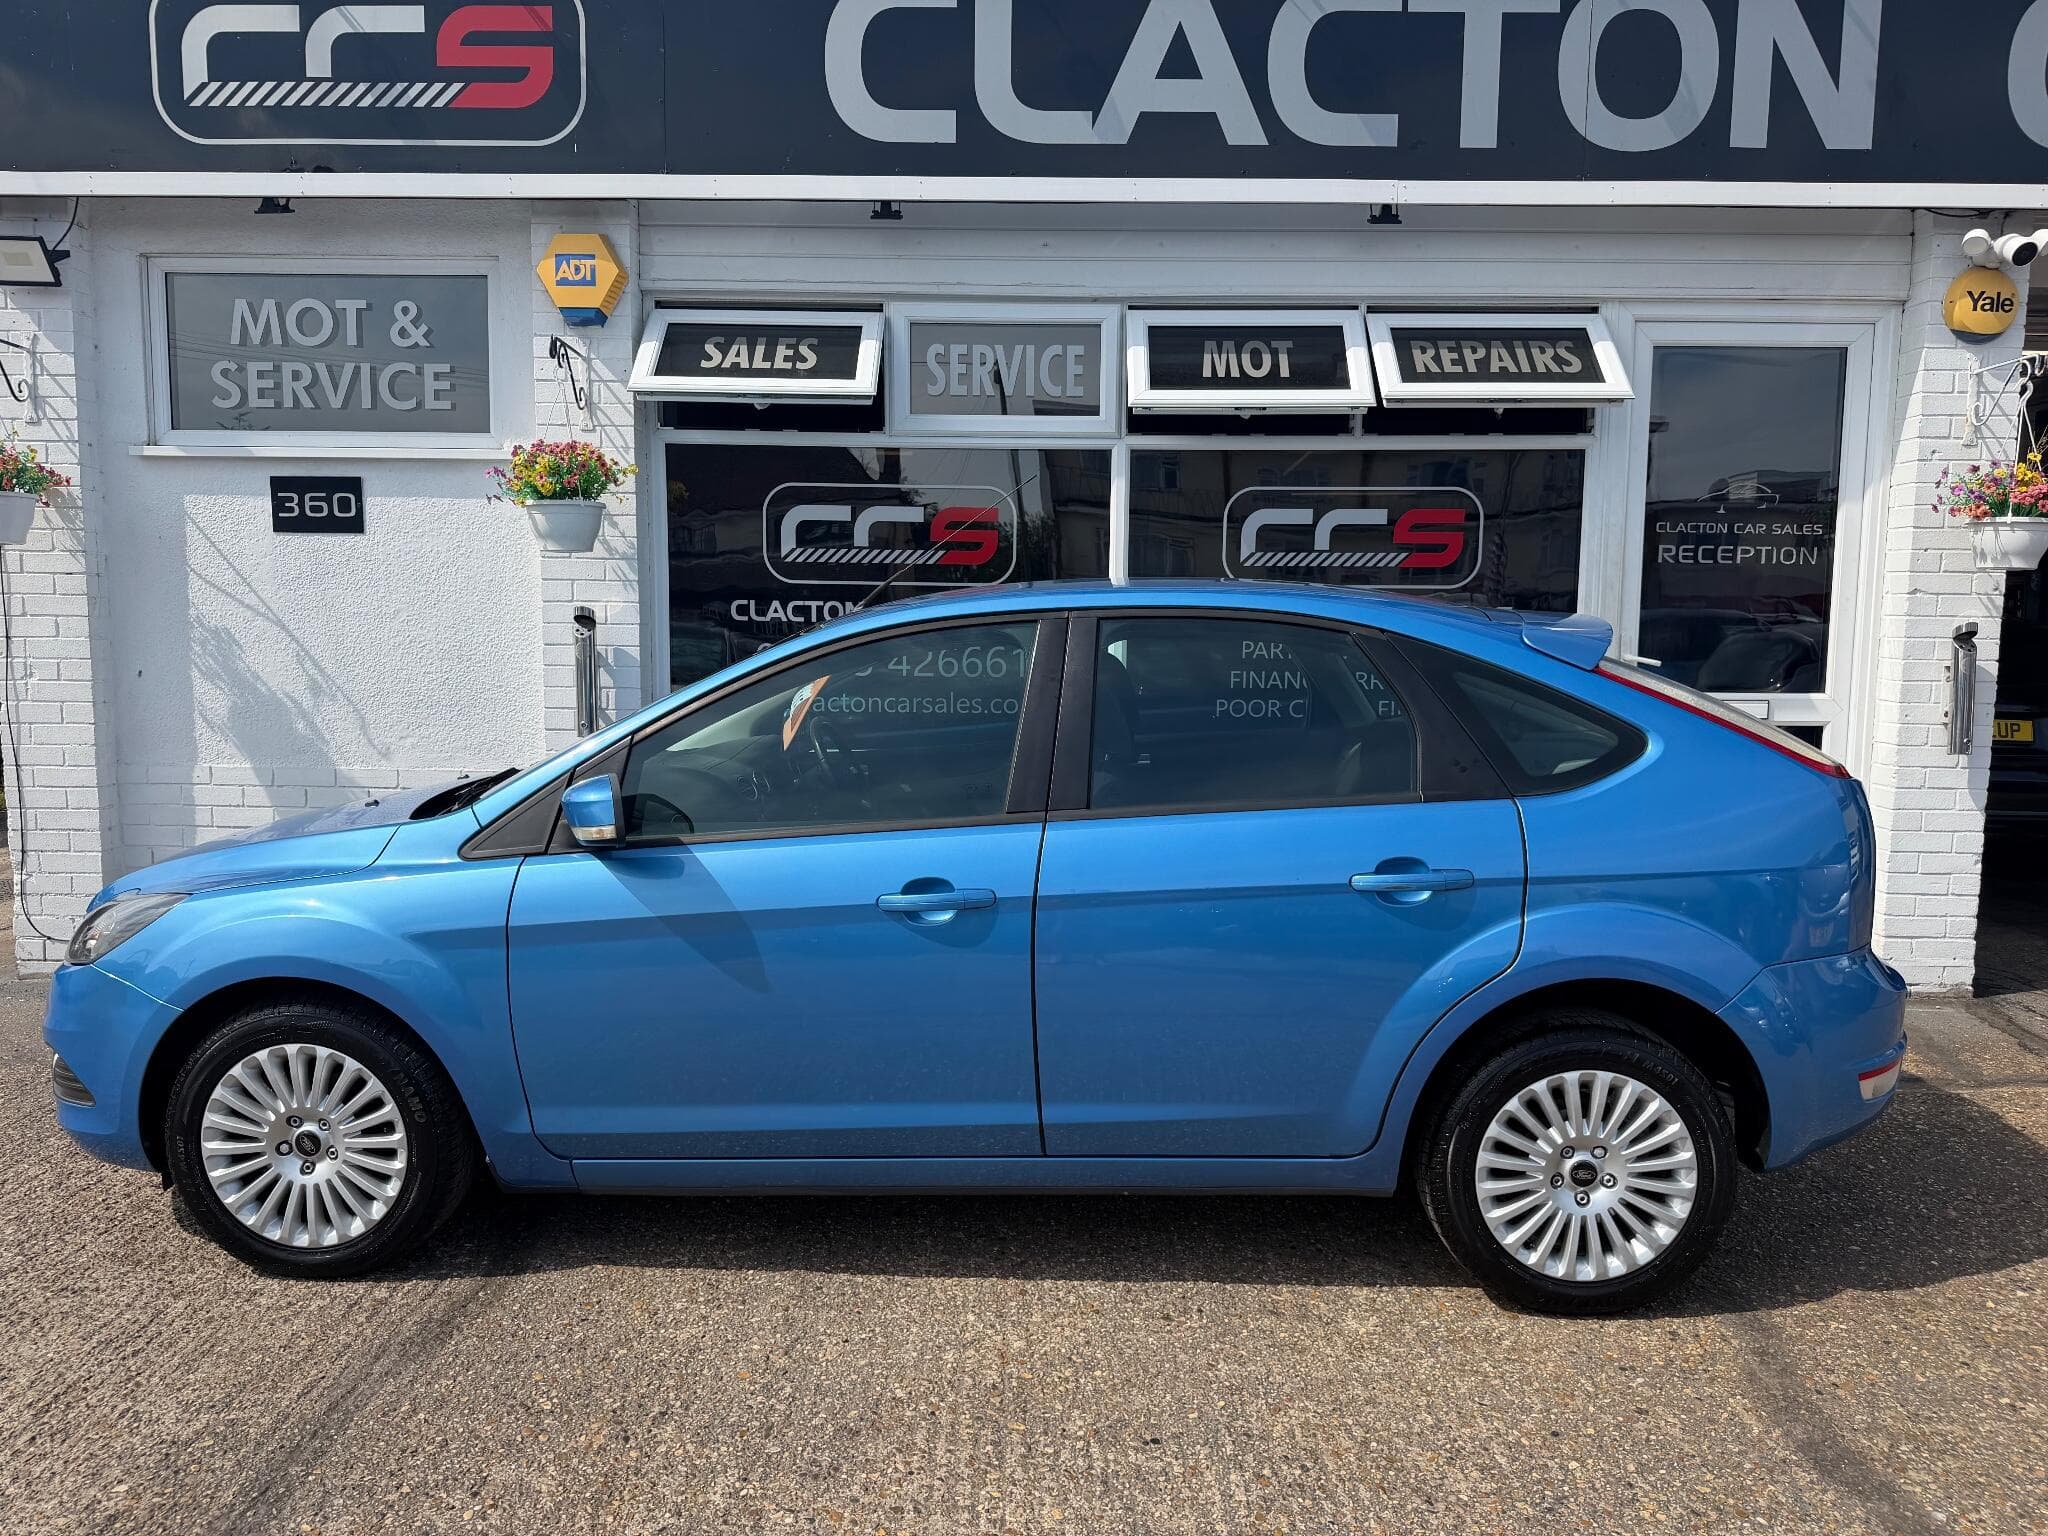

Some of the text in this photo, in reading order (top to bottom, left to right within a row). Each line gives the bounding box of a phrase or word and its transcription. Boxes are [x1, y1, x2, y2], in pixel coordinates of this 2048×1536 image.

[824, 0, 1881, 151] CLACTON
[556, 259, 595, 281] ADT
[1967, 290, 2014, 313] Yale
[231, 299, 431, 348] MOT &
[700, 336, 818, 371] SALES
[1202, 340, 1293, 379] MOT
[1410, 340, 1583, 375] REPAIRS
[926, 343, 1085, 397] SERVICE
[211, 360, 453, 410] SERVICE
[278, 492, 356, 519] 360
[1656, 521, 1824, 535] CLACTON CAR SALES
[1657, 544, 1818, 565] RECEPTION
[1242, 640, 1292, 660] PAR
[1230, 670, 1308, 689] FINAN
[1216, 699, 1281, 718] POOR
[1992, 721, 2021, 739] UP
